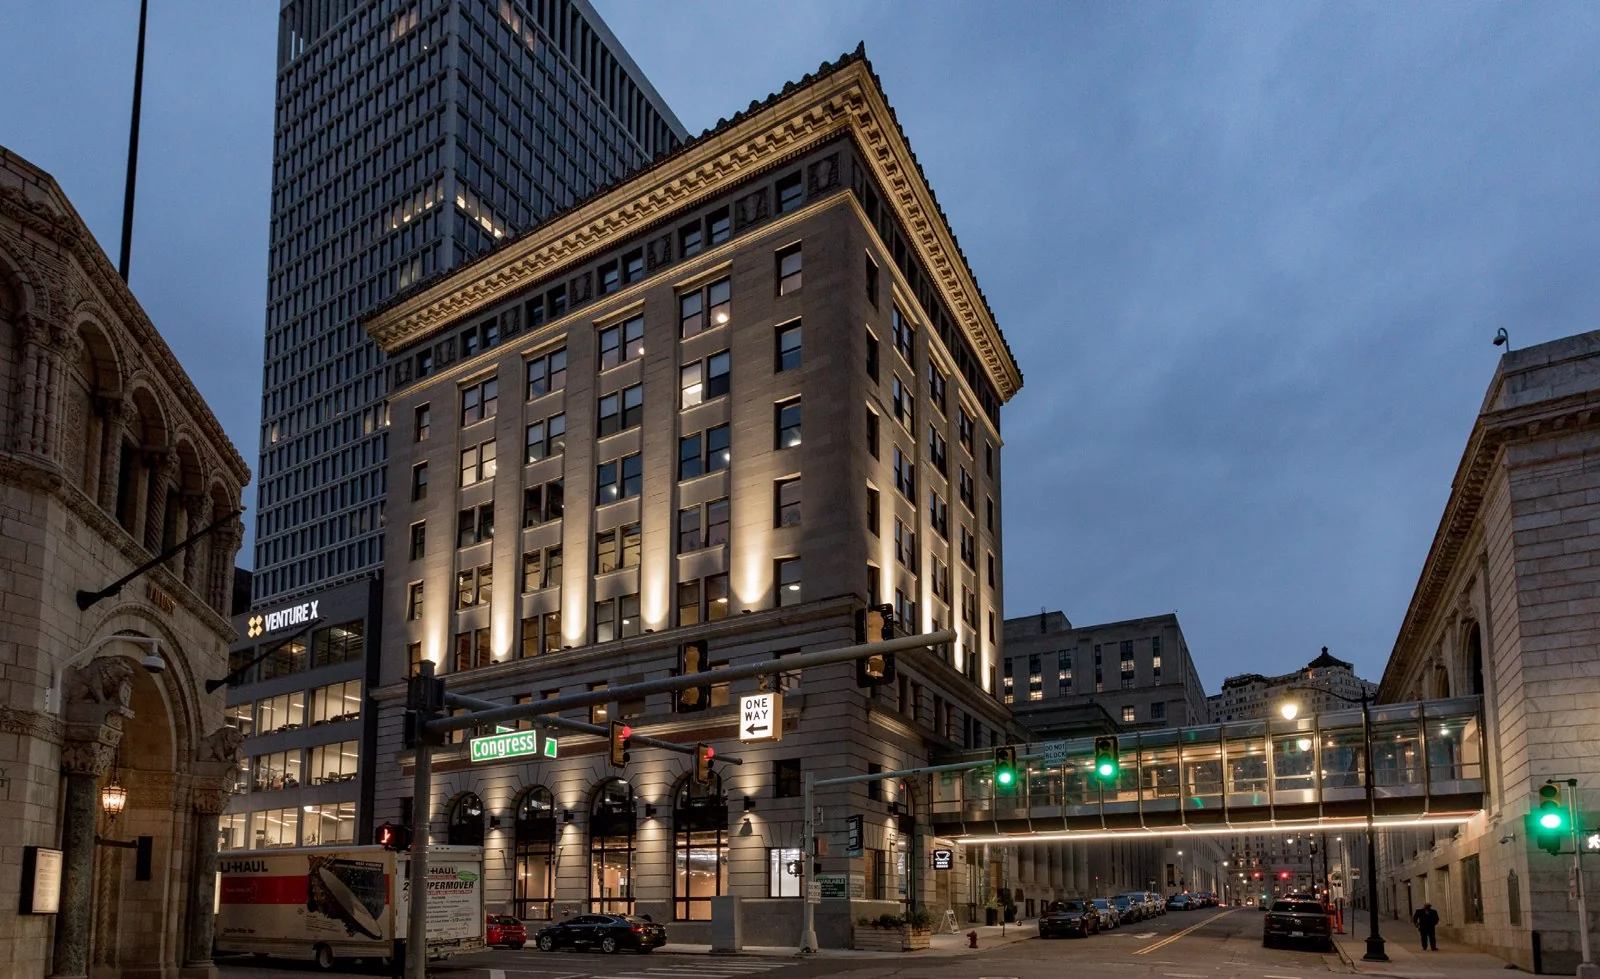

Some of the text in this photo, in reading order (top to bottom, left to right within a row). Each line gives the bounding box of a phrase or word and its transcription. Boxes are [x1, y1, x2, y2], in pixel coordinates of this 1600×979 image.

[264, 603, 309, 632] VENTURE
[310, 600, 319, 620] X
[745, 698, 768, 710] ONE
[745, 709, 768, 721] WAY
[473, 735, 533, 756] Congress
[1054, 743, 1065, 751] NOT
[1045, 751, 1066, 759] BLOCK
[220, 861, 268, 873] U-HAUL
[427, 881, 474, 890] PERMOVER
